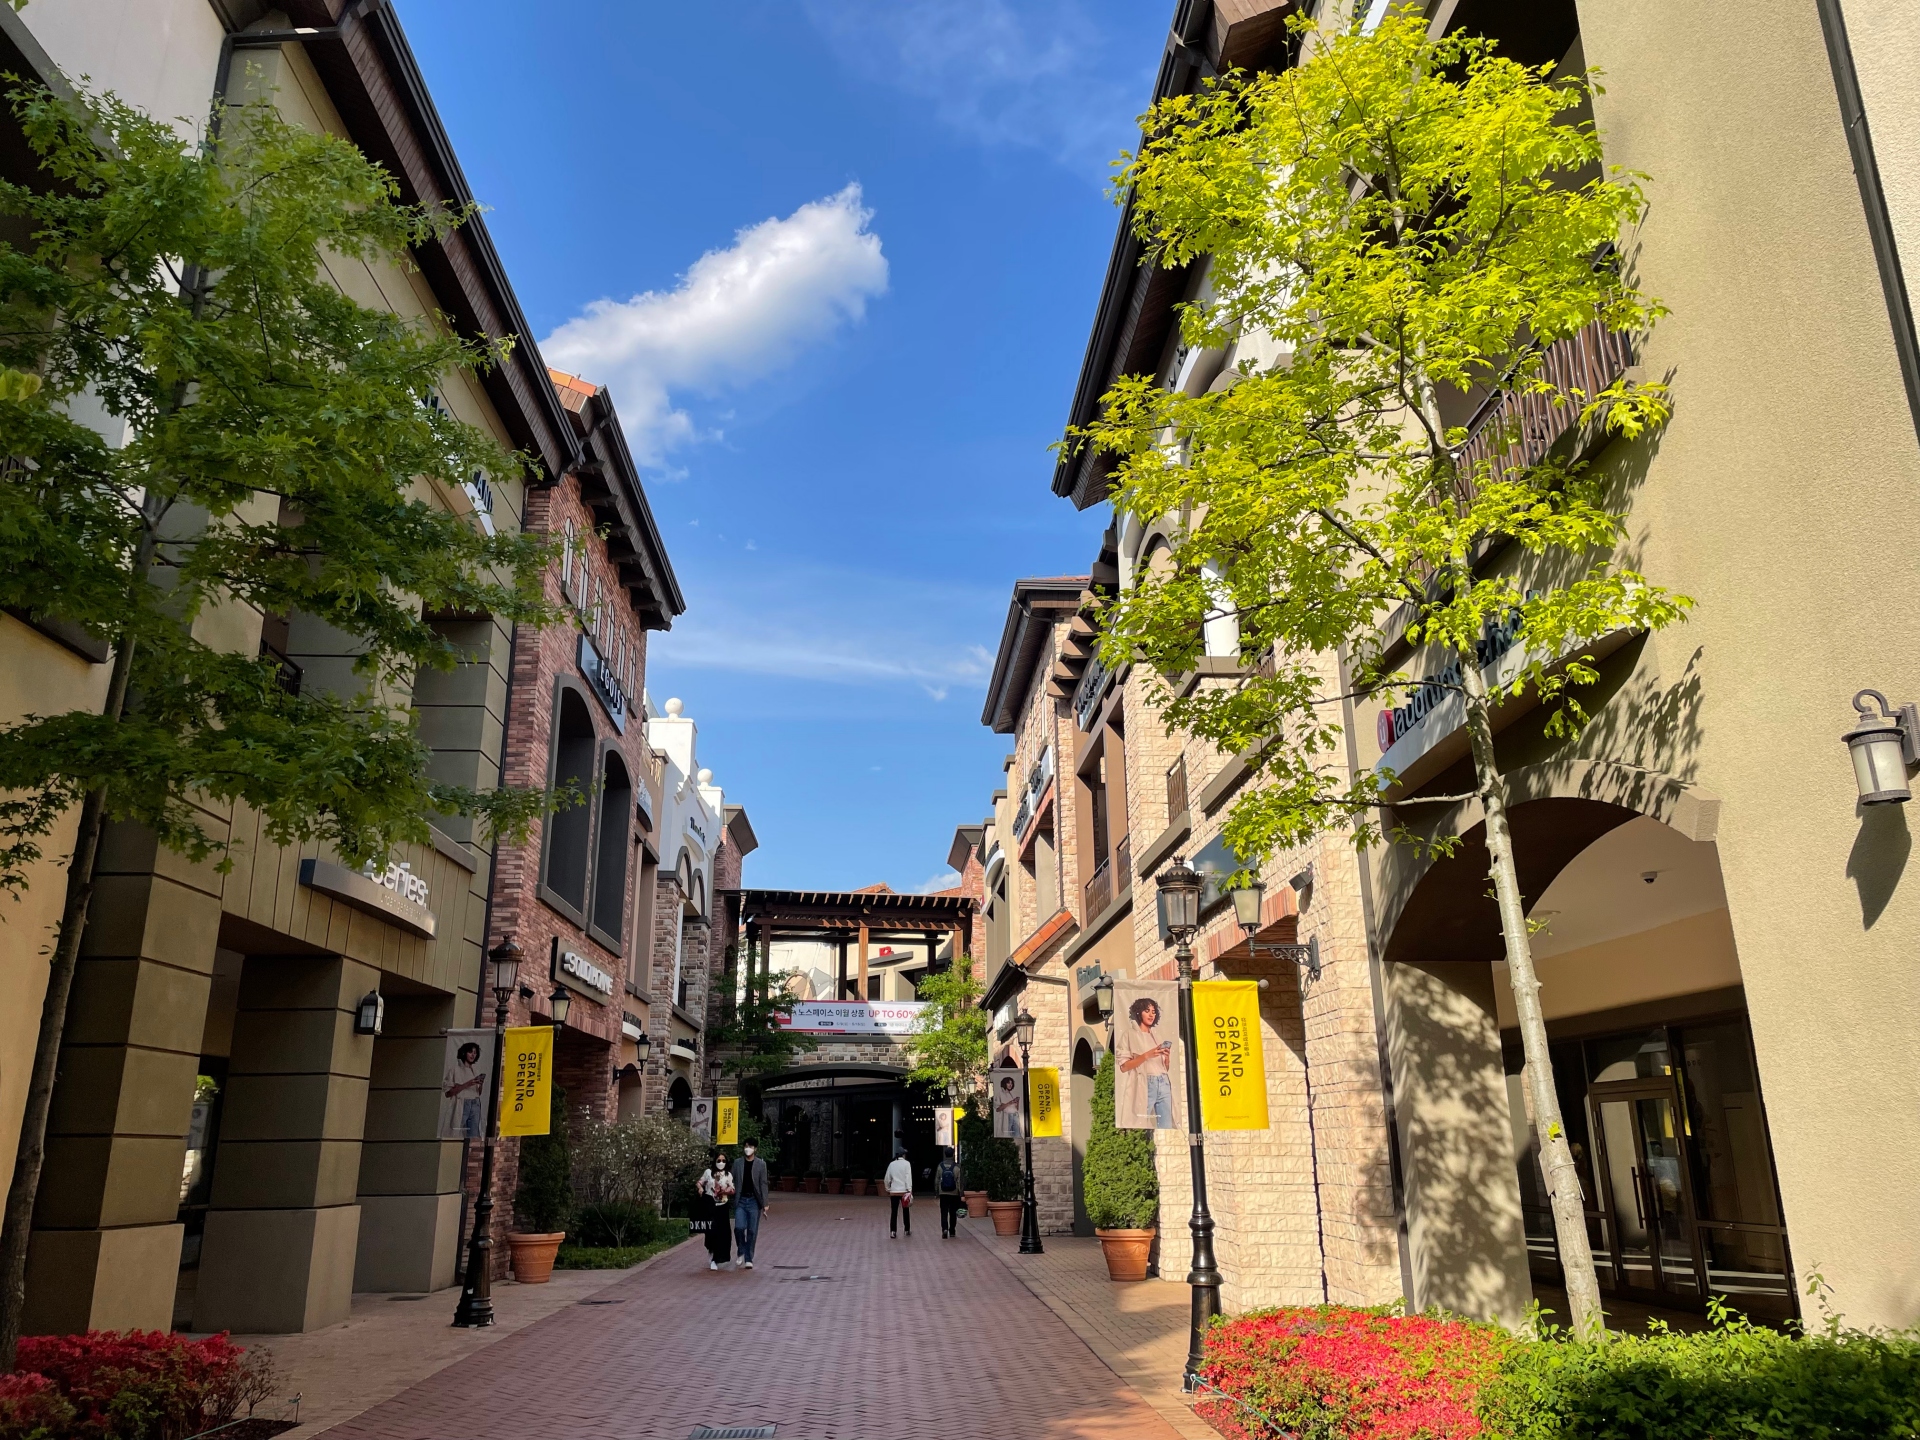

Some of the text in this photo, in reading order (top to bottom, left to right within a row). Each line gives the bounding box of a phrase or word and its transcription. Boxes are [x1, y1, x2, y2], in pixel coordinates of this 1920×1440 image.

[600, 659, 626, 713] EGOIST
[798, 1008, 834, 1017] 노스페이스
[835, 1008, 850, 1018] 이월
[850, 1009, 865, 1018] 상품
[868, 1009, 880, 1018] UP
[882, 1009, 895, 1018] TO
[896, 1009, 918, 1019] 60%
[1213, 1016, 1232, 1097] OPENING
[1227, 1016, 1244, 1078] GRAND
[514, 1052, 527, 1112] OPENING
[526, 1052, 537, 1098] GRAND
[1044, 1083, 1052, 1113] GRAND
[1037, 1083, 1046, 1121] OPENING
